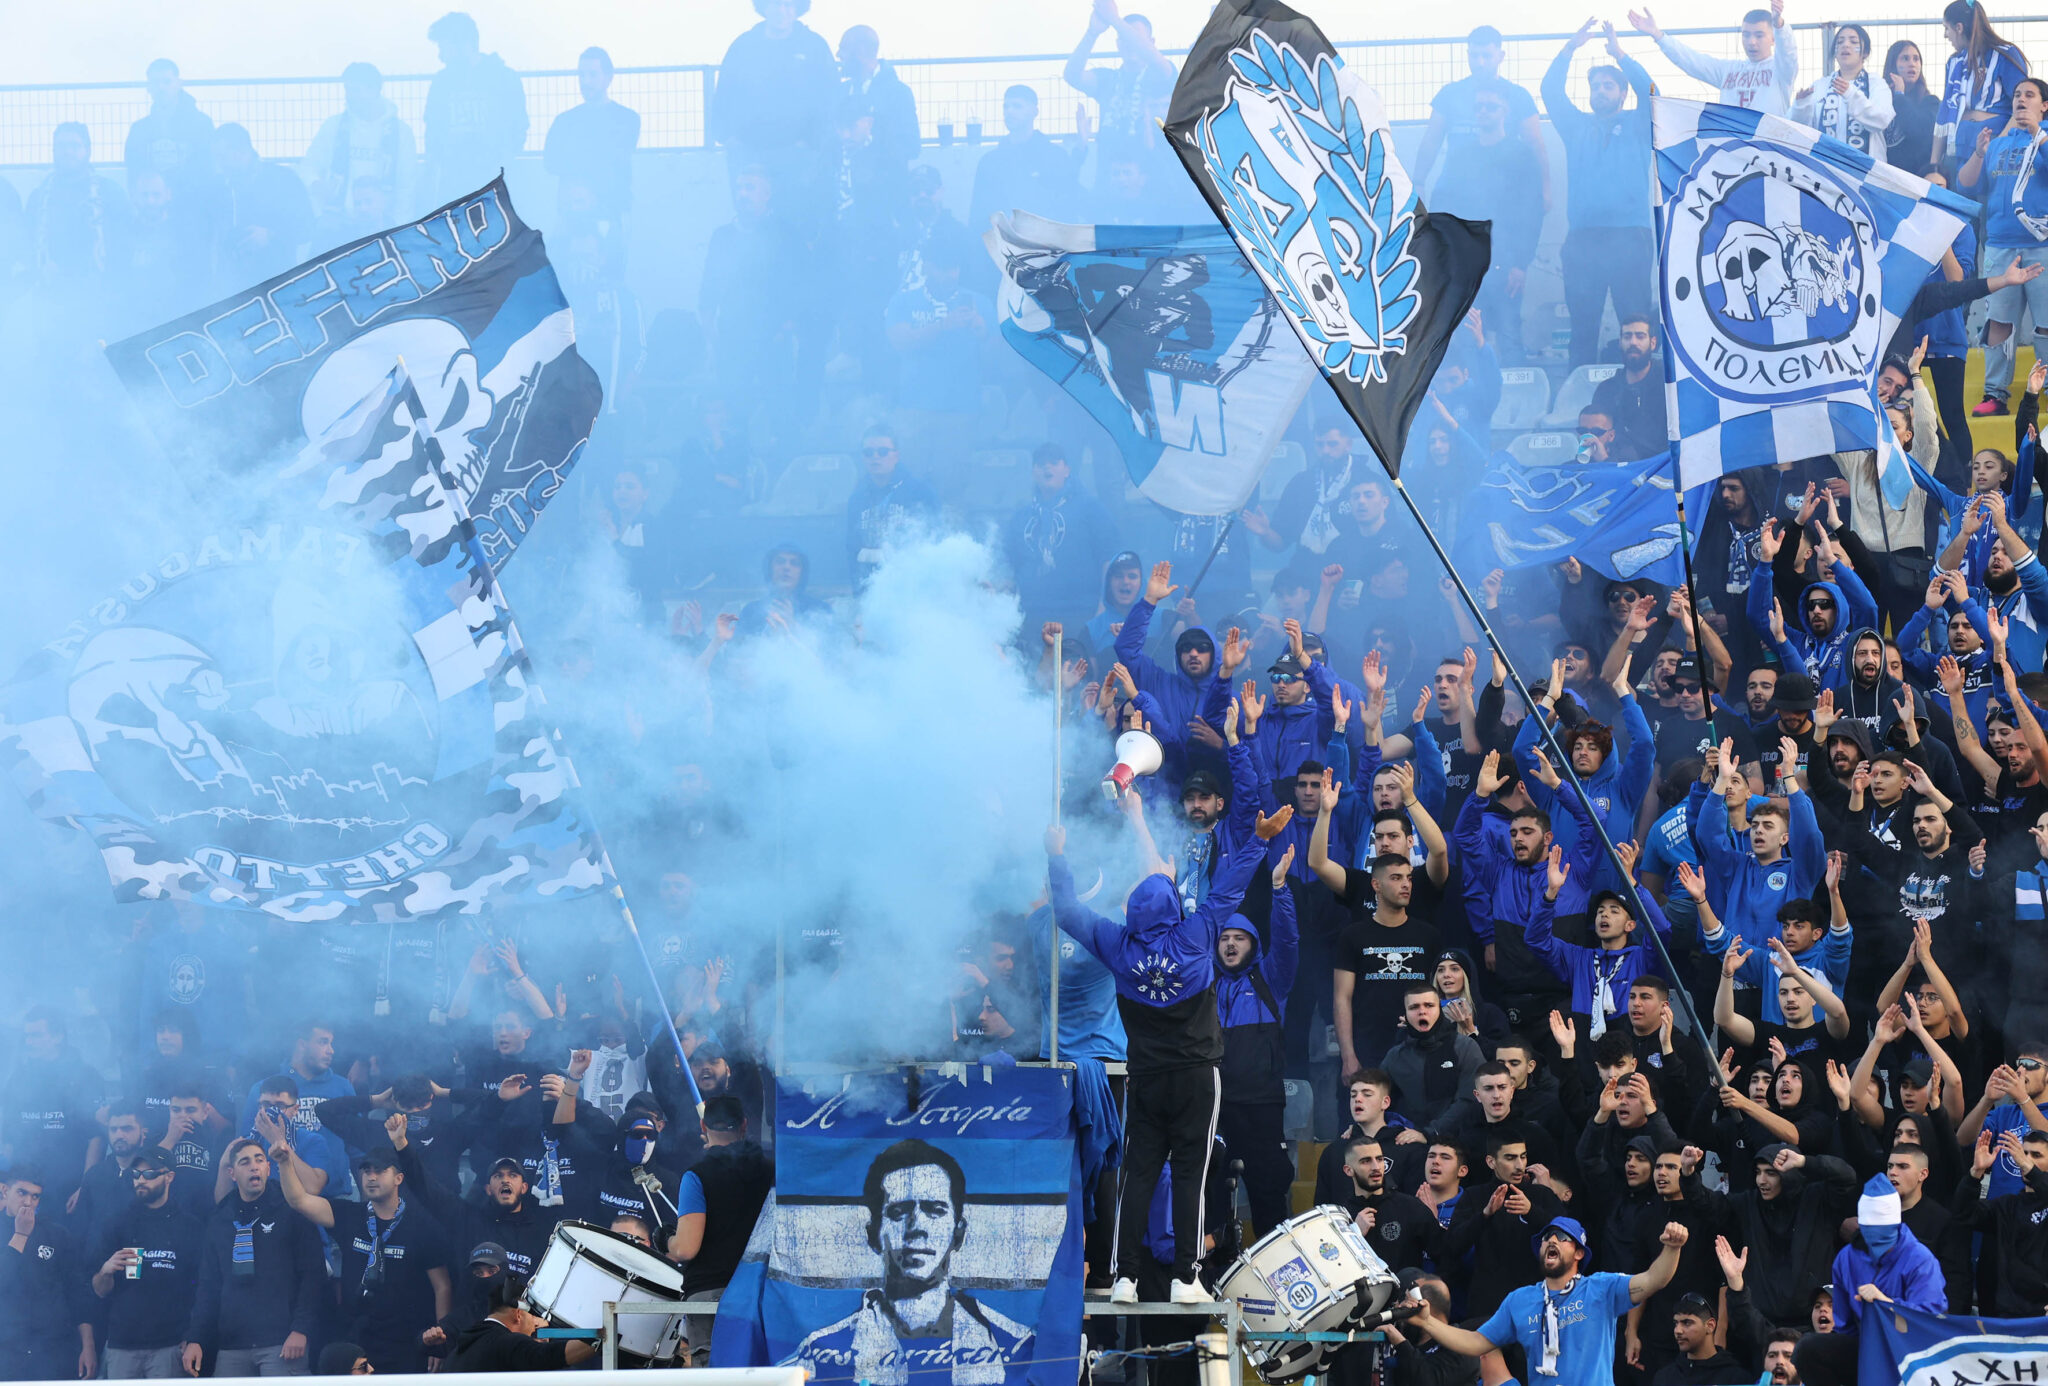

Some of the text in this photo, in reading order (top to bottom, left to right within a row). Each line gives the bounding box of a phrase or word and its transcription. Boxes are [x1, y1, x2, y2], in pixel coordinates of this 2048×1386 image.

[146, 188, 510, 408] DEFEND
[1131, 952, 1180, 976] INSANE
[1137, 981, 1183, 1003] BRAIN
[1291, 1284, 1314, 1306] 1911
